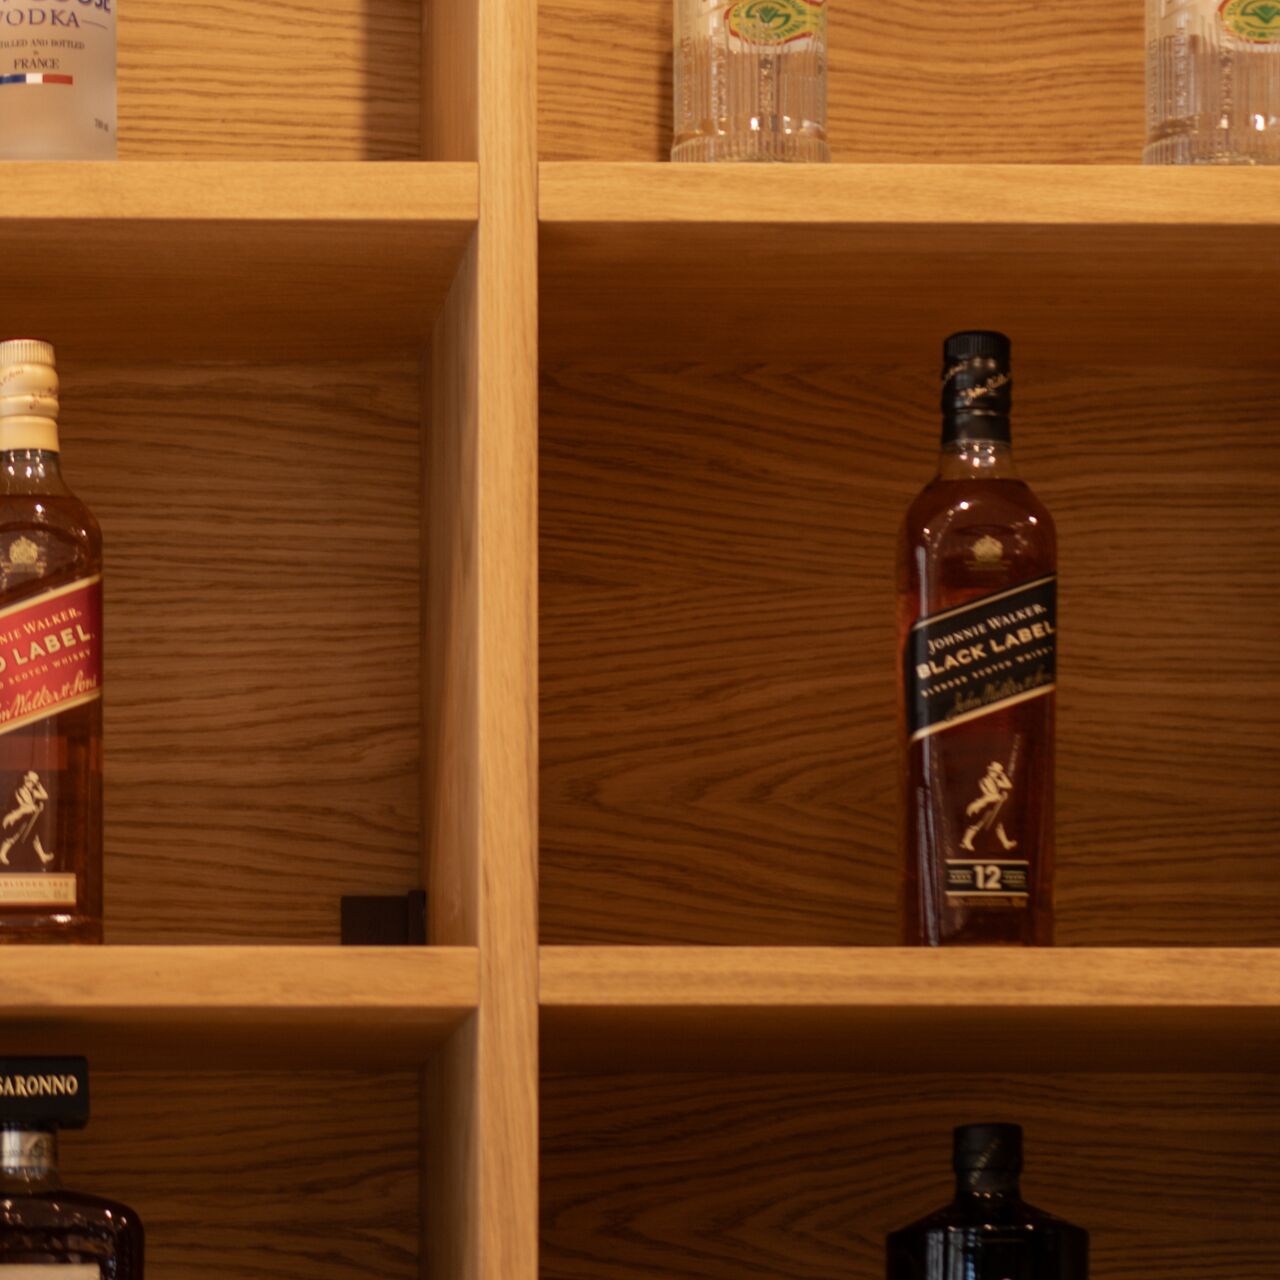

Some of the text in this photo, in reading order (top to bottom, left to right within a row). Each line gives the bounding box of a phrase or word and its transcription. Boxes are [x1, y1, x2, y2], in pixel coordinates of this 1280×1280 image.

[31, 39, 48, 47] AND
[51, 40, 86, 50] BOTTLED
[13, 58, 60, 70] FRANCE
[23, 607, 78, 635] WALKER
[927, 603, 1043, 656] JOHNNIE WALKER
[12, 624, 92, 666] LABEL
[916, 620, 1055, 680] BLACK LABEL
[8, 665, 49, 684] SCOTCH
[52, 649, 92, 669] WHISKY
[974, 865, 1002, 890] 12
